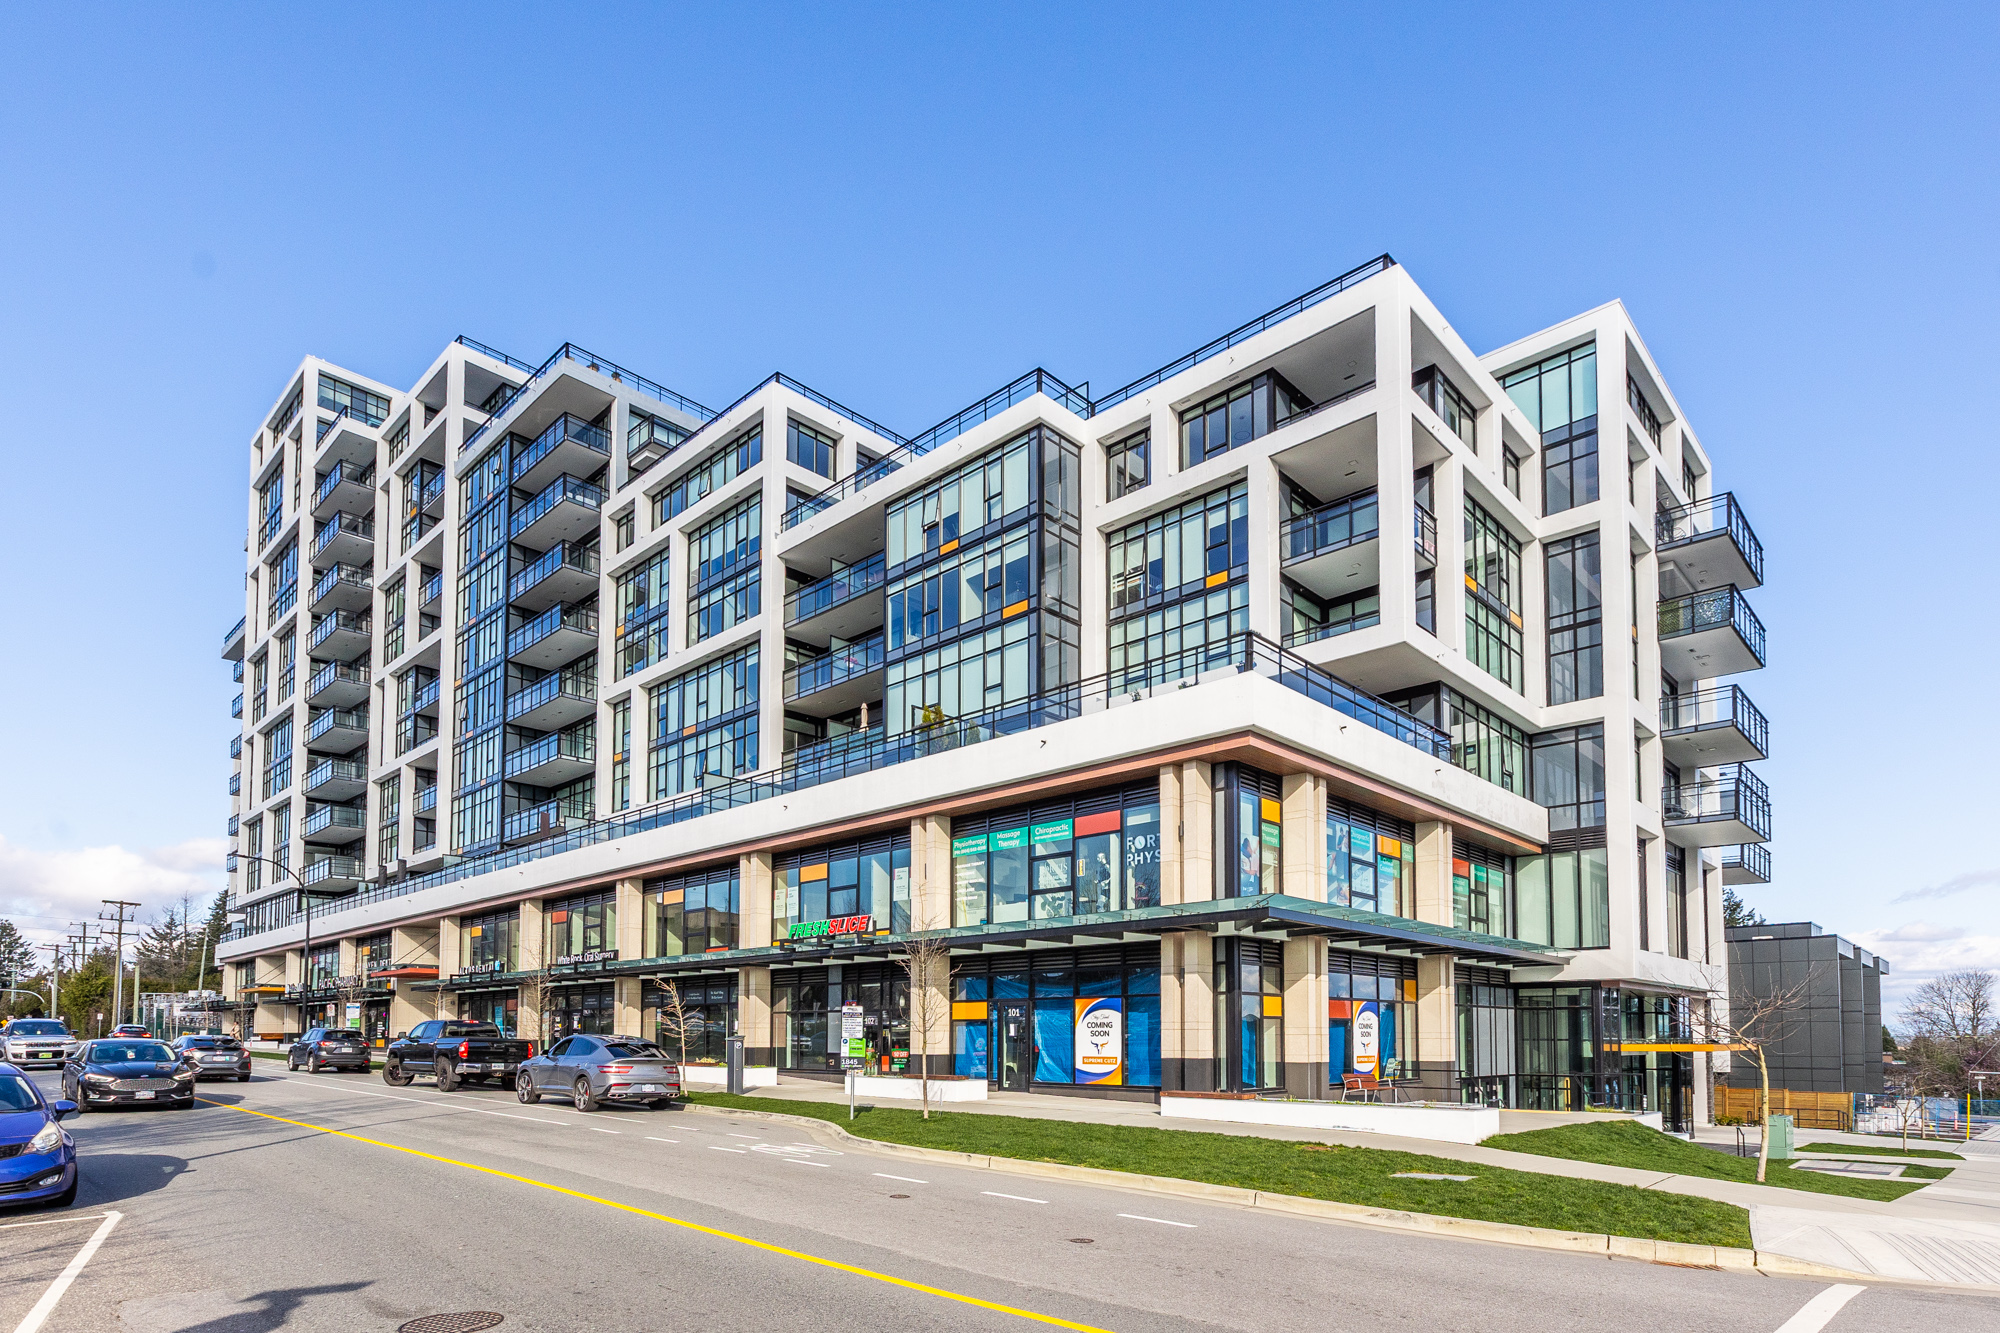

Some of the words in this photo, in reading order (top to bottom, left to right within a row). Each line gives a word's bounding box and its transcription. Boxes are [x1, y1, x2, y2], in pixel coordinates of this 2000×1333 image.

[997, 830, 1021, 839] Massage
[1035, 823, 1069, 835] Chiropractic
[1262, 825, 1279, 836] Massage
[954, 838, 986, 849] Physiotherapy
[998, 839, 1020, 848] Therapy
[1262, 834, 1278, 845] Therapy
[1127, 849, 1161, 866] PHYS
[788, 914, 870, 939] FRESHSLICE
[557, 955, 570, 965] White
[570, 954, 583, 963] Rock
[584, 951, 594, 962] Oral
[594, 951, 615, 961] Surgery
[1008, 1008, 1020, 1017] 101
[1086, 1021, 1113, 1029] COMING
[1358, 1022, 1373, 1030] COMING
[1360, 1030, 1371, 1038] SOON
